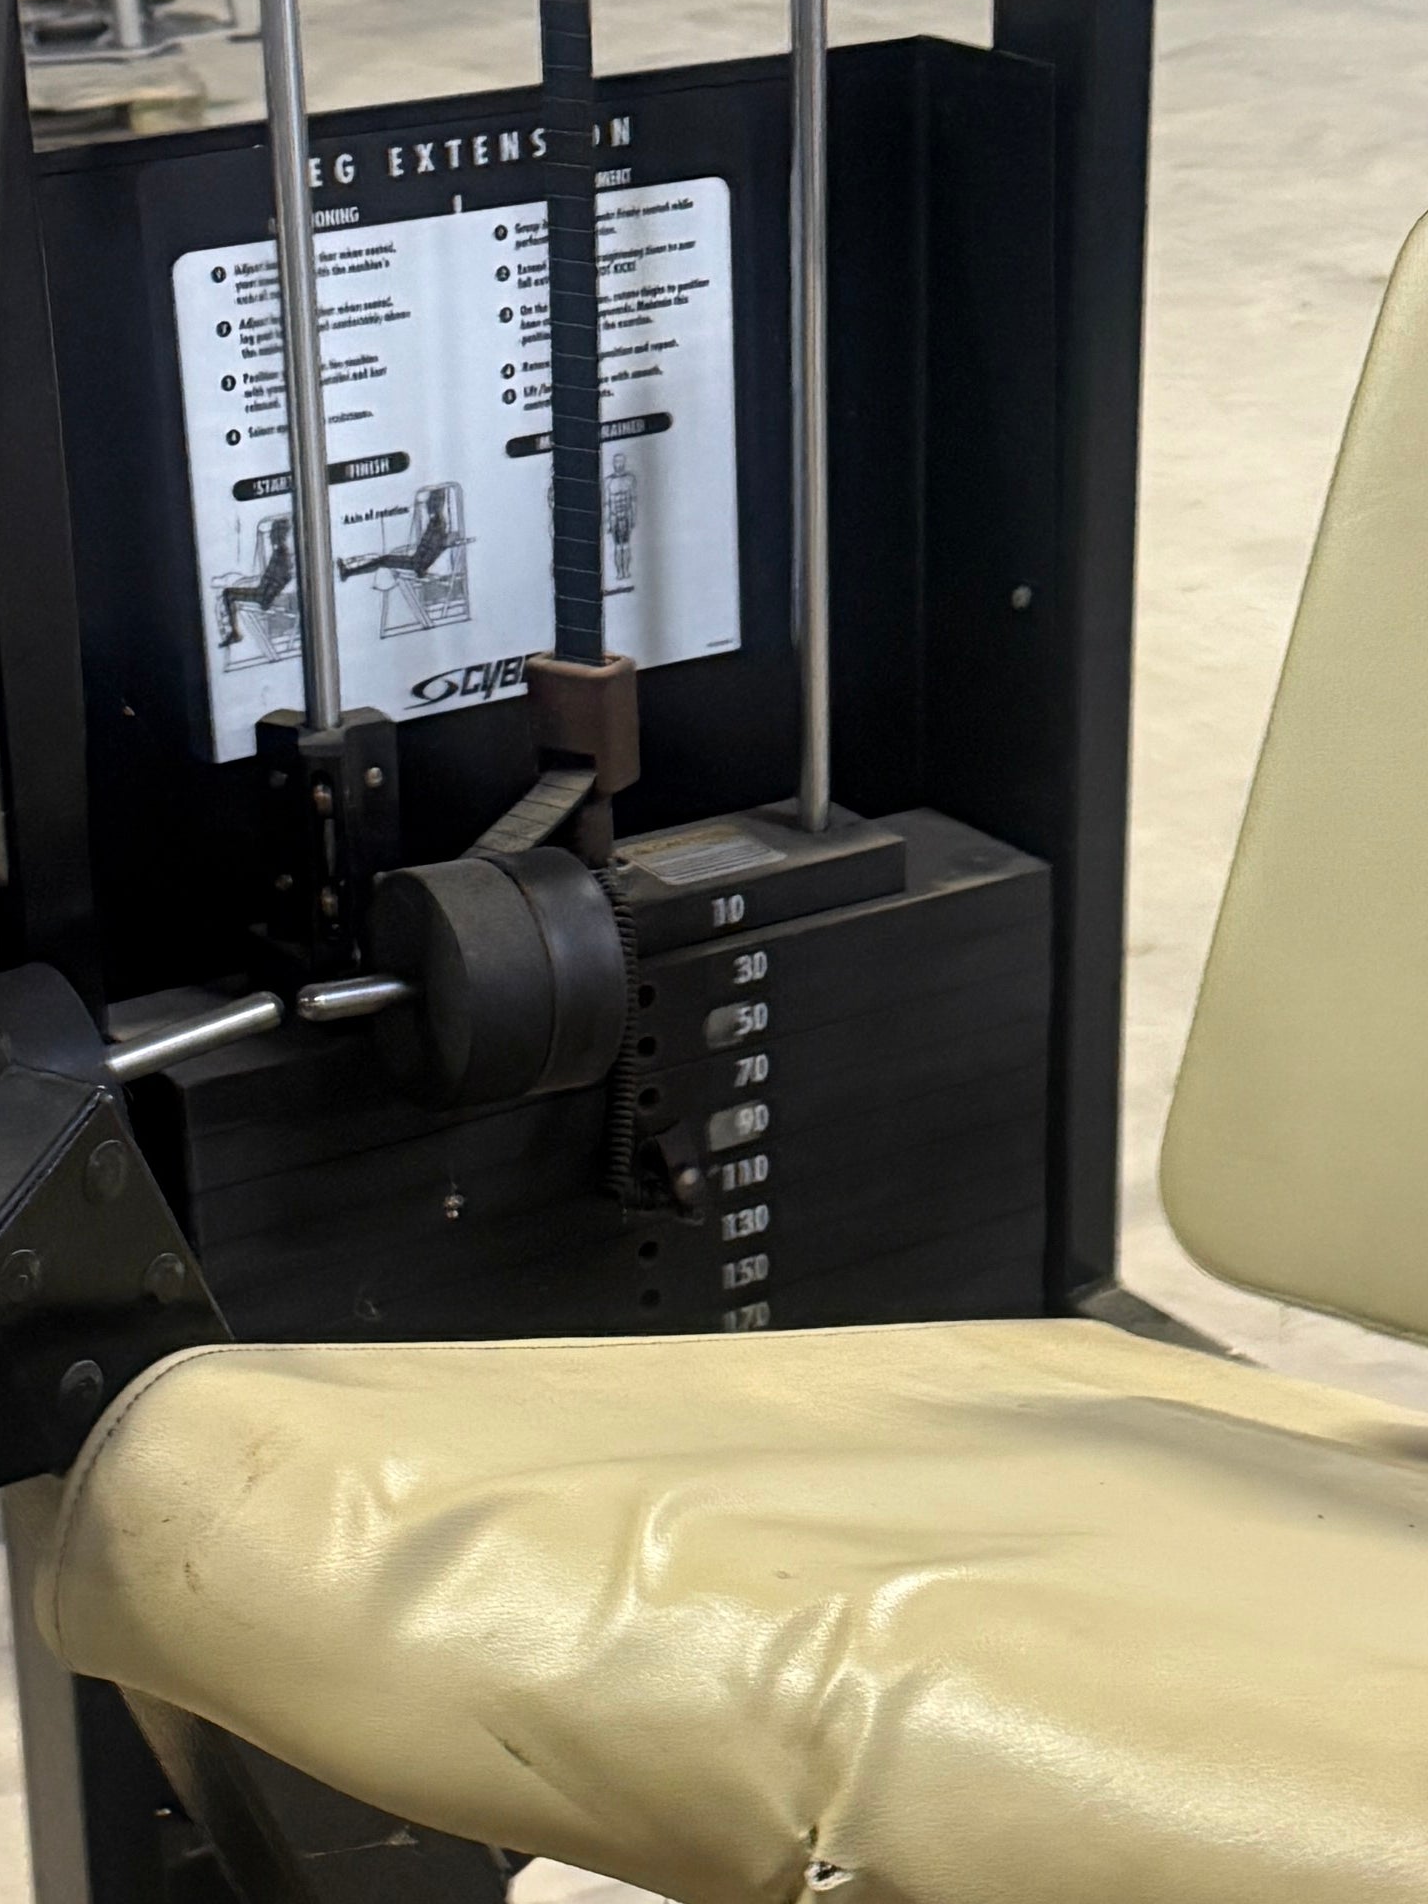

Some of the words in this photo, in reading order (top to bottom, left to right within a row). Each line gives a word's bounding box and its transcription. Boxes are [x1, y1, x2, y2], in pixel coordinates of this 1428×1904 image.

[310, 152, 356, 188] EG
[388, 116, 631, 178] EXTENSN
[601, 418, 645, 438] RAINED
[712, 894, 745, 928] 10
[733, 951, 768, 985] 30
[735, 1002, 769, 1036] 50
[734, 1053, 769, 1088] 70
[735, 1104, 770, 1137] 90
[722, 1154, 769, 1192] 110
[722, 1204, 770, 1241] 130
[722, 1253, 770, 1290] 150
[724, 1300, 770, 1333] 170
